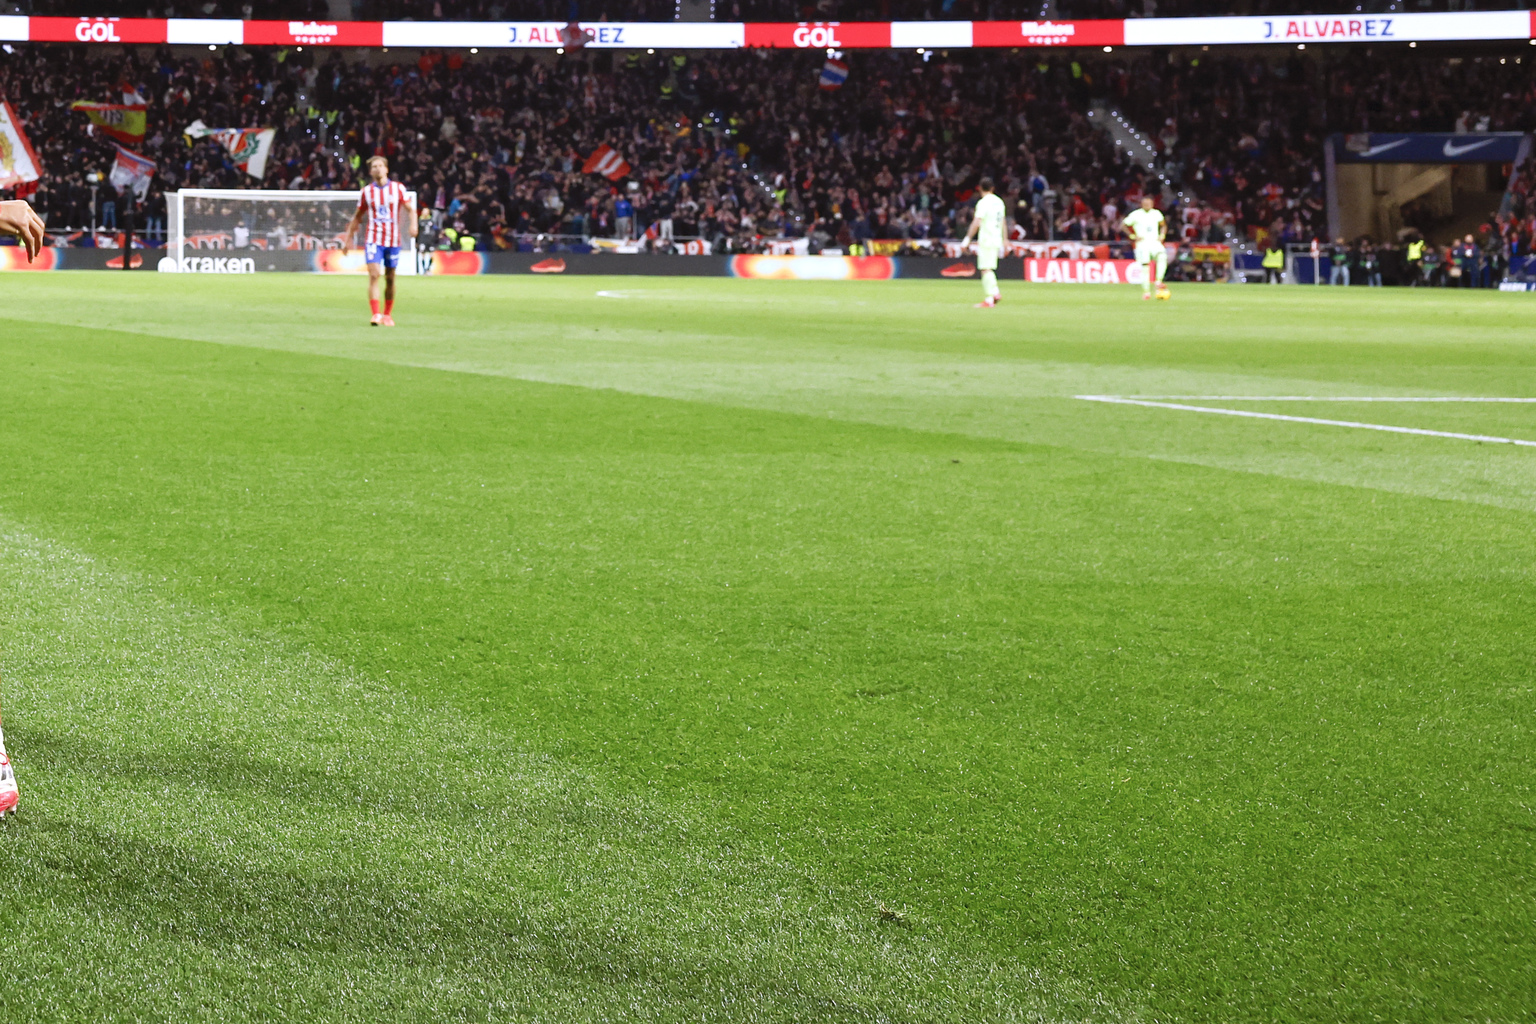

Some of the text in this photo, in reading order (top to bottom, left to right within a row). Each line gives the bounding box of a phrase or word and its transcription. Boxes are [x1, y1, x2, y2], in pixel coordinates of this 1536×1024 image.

[75, 22, 120, 42] GOL
[509, 27, 523, 43] J.
[793, 27, 841, 47] GOL
[1263, 19, 1394, 39] J. ALVAREZ
[179, 257, 255, 274] kraken
[1029, 260, 1120, 283] LALIGA
